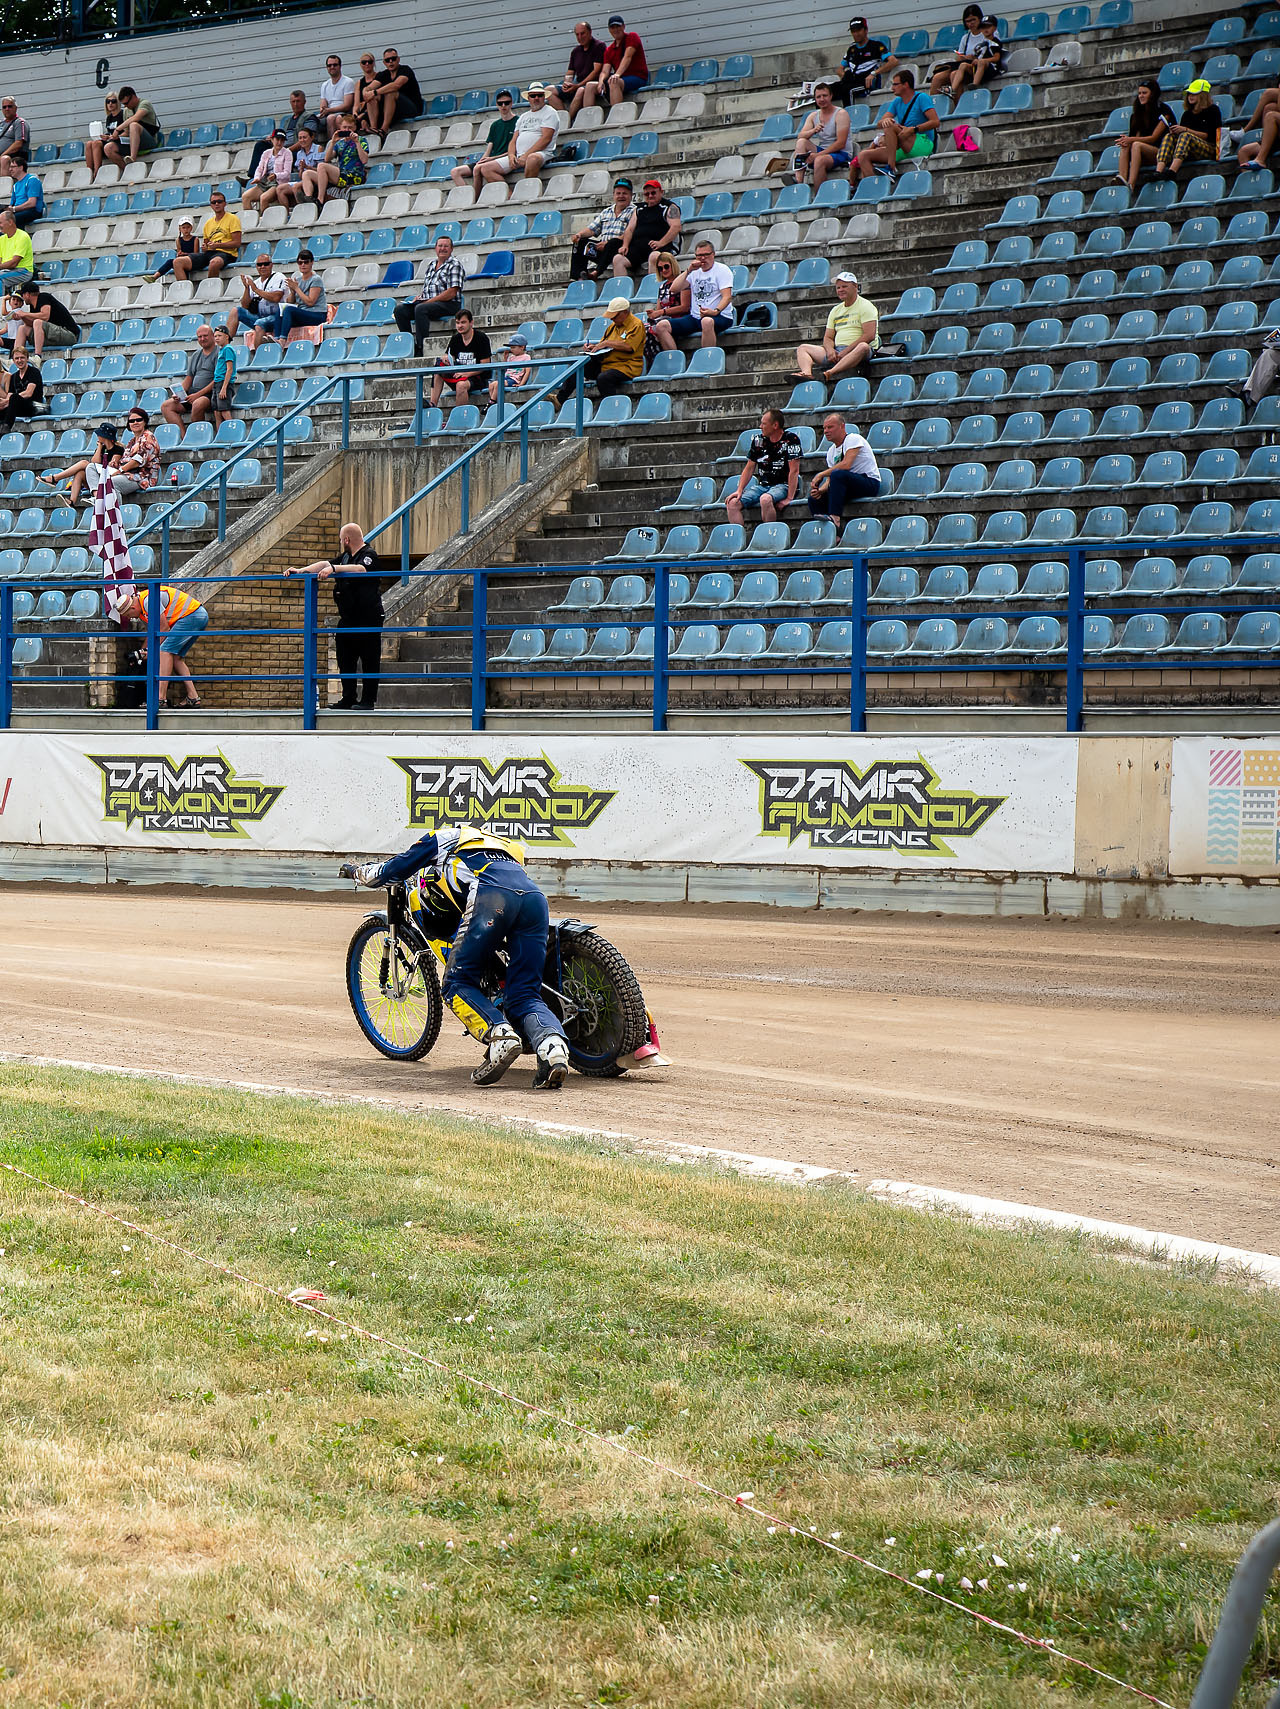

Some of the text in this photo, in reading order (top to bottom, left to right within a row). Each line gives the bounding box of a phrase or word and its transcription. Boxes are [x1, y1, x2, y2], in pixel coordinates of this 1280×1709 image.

[96, 57, 110, 89] C
[145, 814, 231, 830] RACING
[813, 828, 929, 846] RACING
